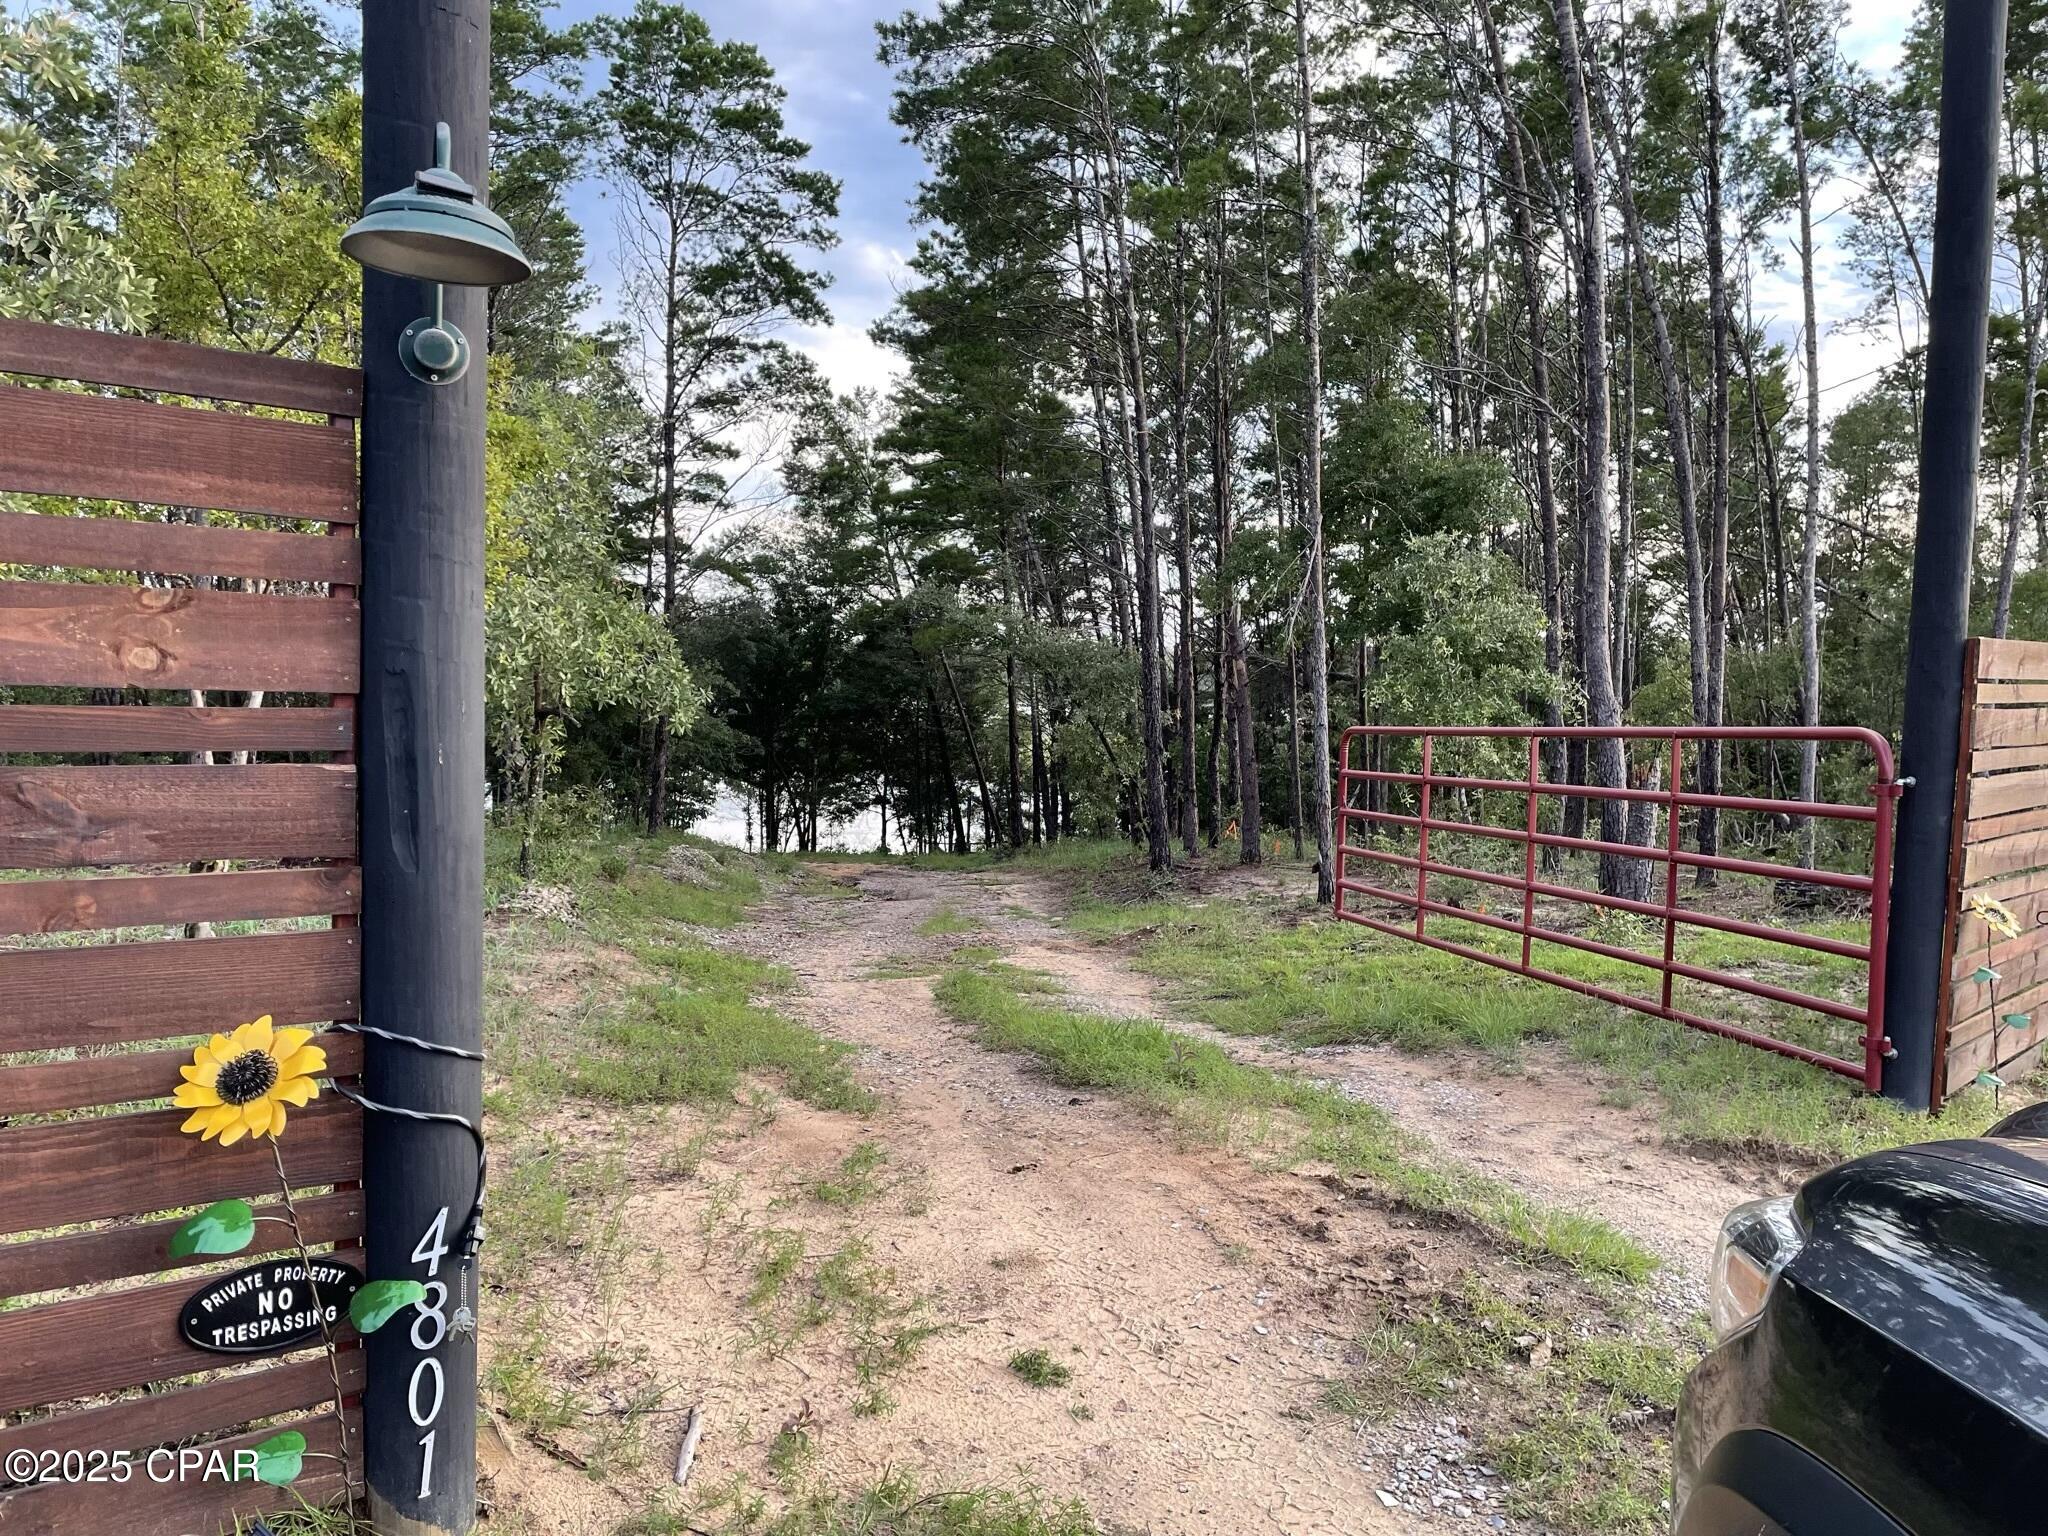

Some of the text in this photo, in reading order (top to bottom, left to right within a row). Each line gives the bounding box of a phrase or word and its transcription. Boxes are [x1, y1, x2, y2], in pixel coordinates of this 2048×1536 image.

[201, 1272, 264, 1313] PRIVATE
[258, 1287, 294, 1316] NO
[212, 1306, 337, 1346] TRESPASSING
[408, 1206, 449, 1499] 4801
